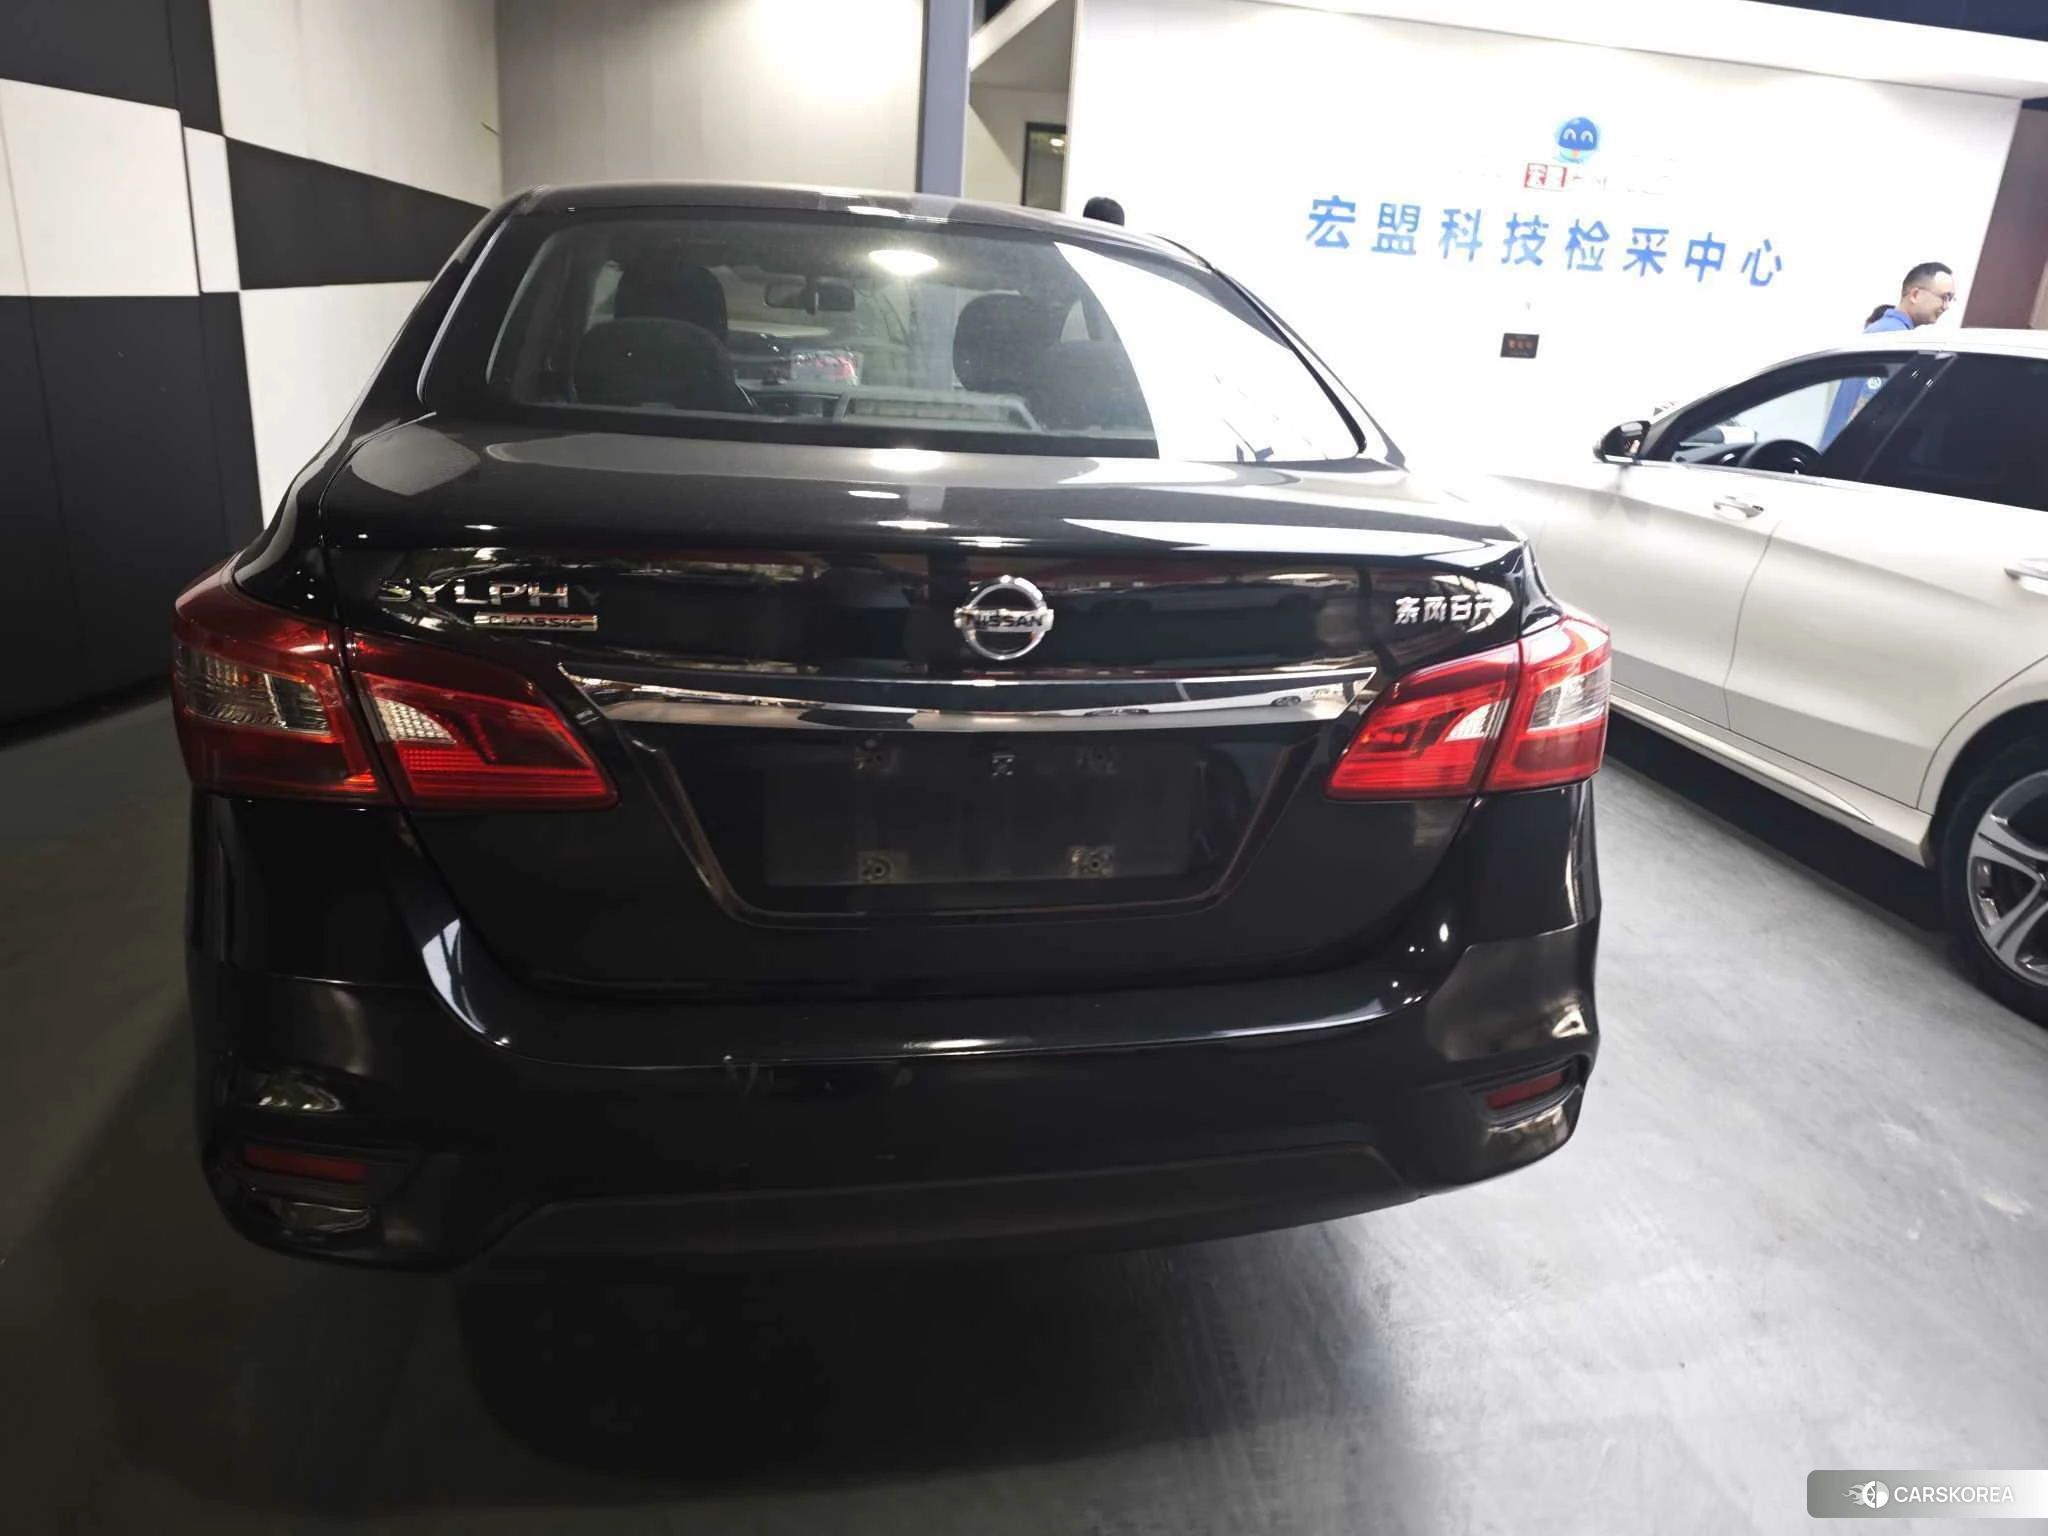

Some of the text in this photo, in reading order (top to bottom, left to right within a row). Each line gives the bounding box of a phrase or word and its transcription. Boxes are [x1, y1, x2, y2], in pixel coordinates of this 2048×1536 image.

[1306, 195, 1782, 287] 宏盟科技检采中心
[488, 615, 584, 629] CLASSIC
[1394, 594, 1494, 626] 东风日产
